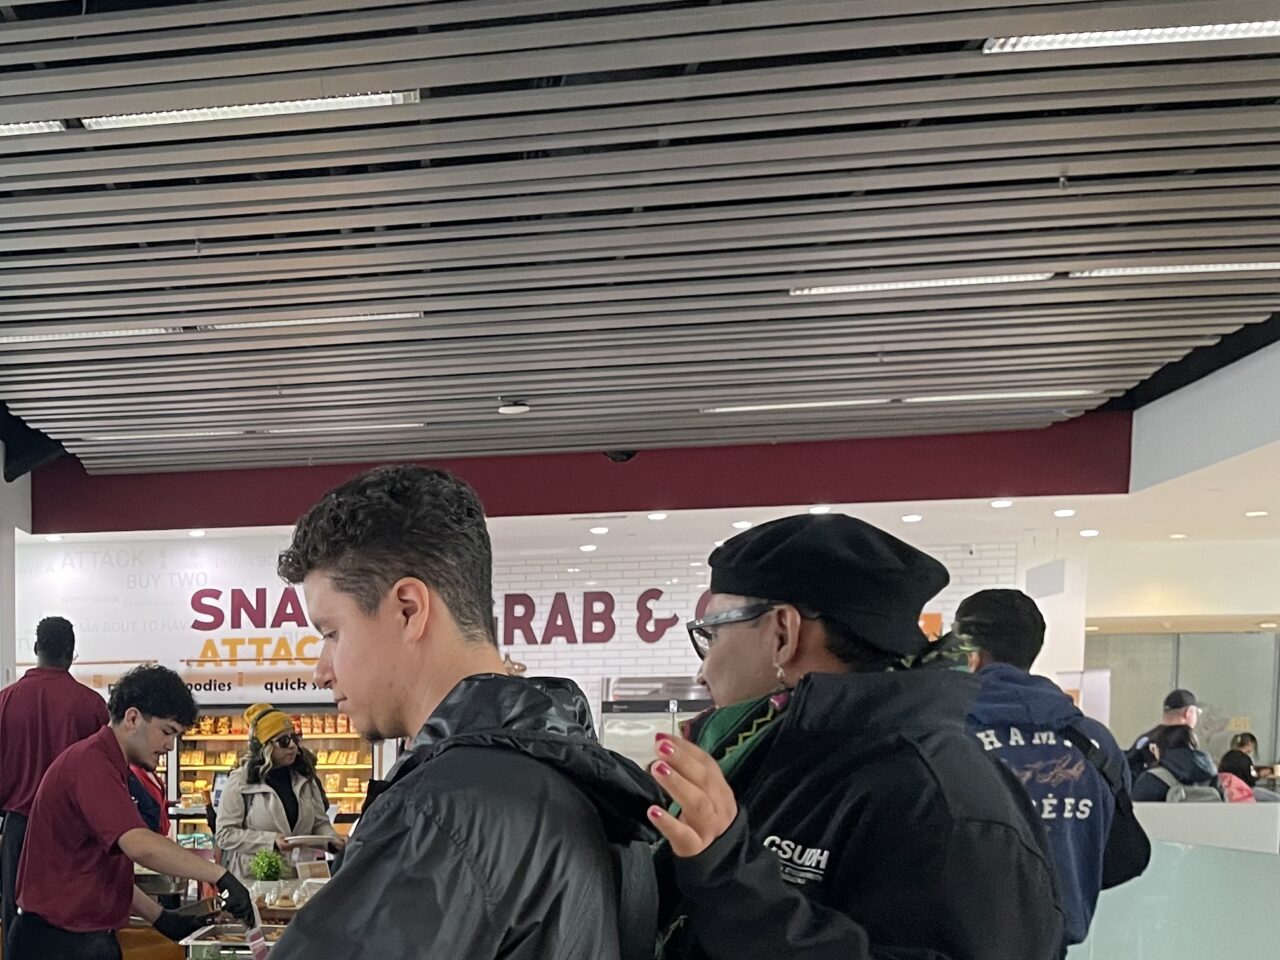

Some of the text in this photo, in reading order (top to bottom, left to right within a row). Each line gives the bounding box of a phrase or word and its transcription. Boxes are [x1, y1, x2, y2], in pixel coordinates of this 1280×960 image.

[60, 550, 144, 570] ATTACK
[127, 572, 207, 589] BUY TWO
[191, 587, 308, 631] SNA
[495, 591, 616, 646] RAB
[636, 588, 680, 644] &
[161, 618, 189, 632] HAV
[197, 635, 320, 667] ATTAC
[185, 679, 232, 692] oodies
[264, 678, 307, 693] quick
